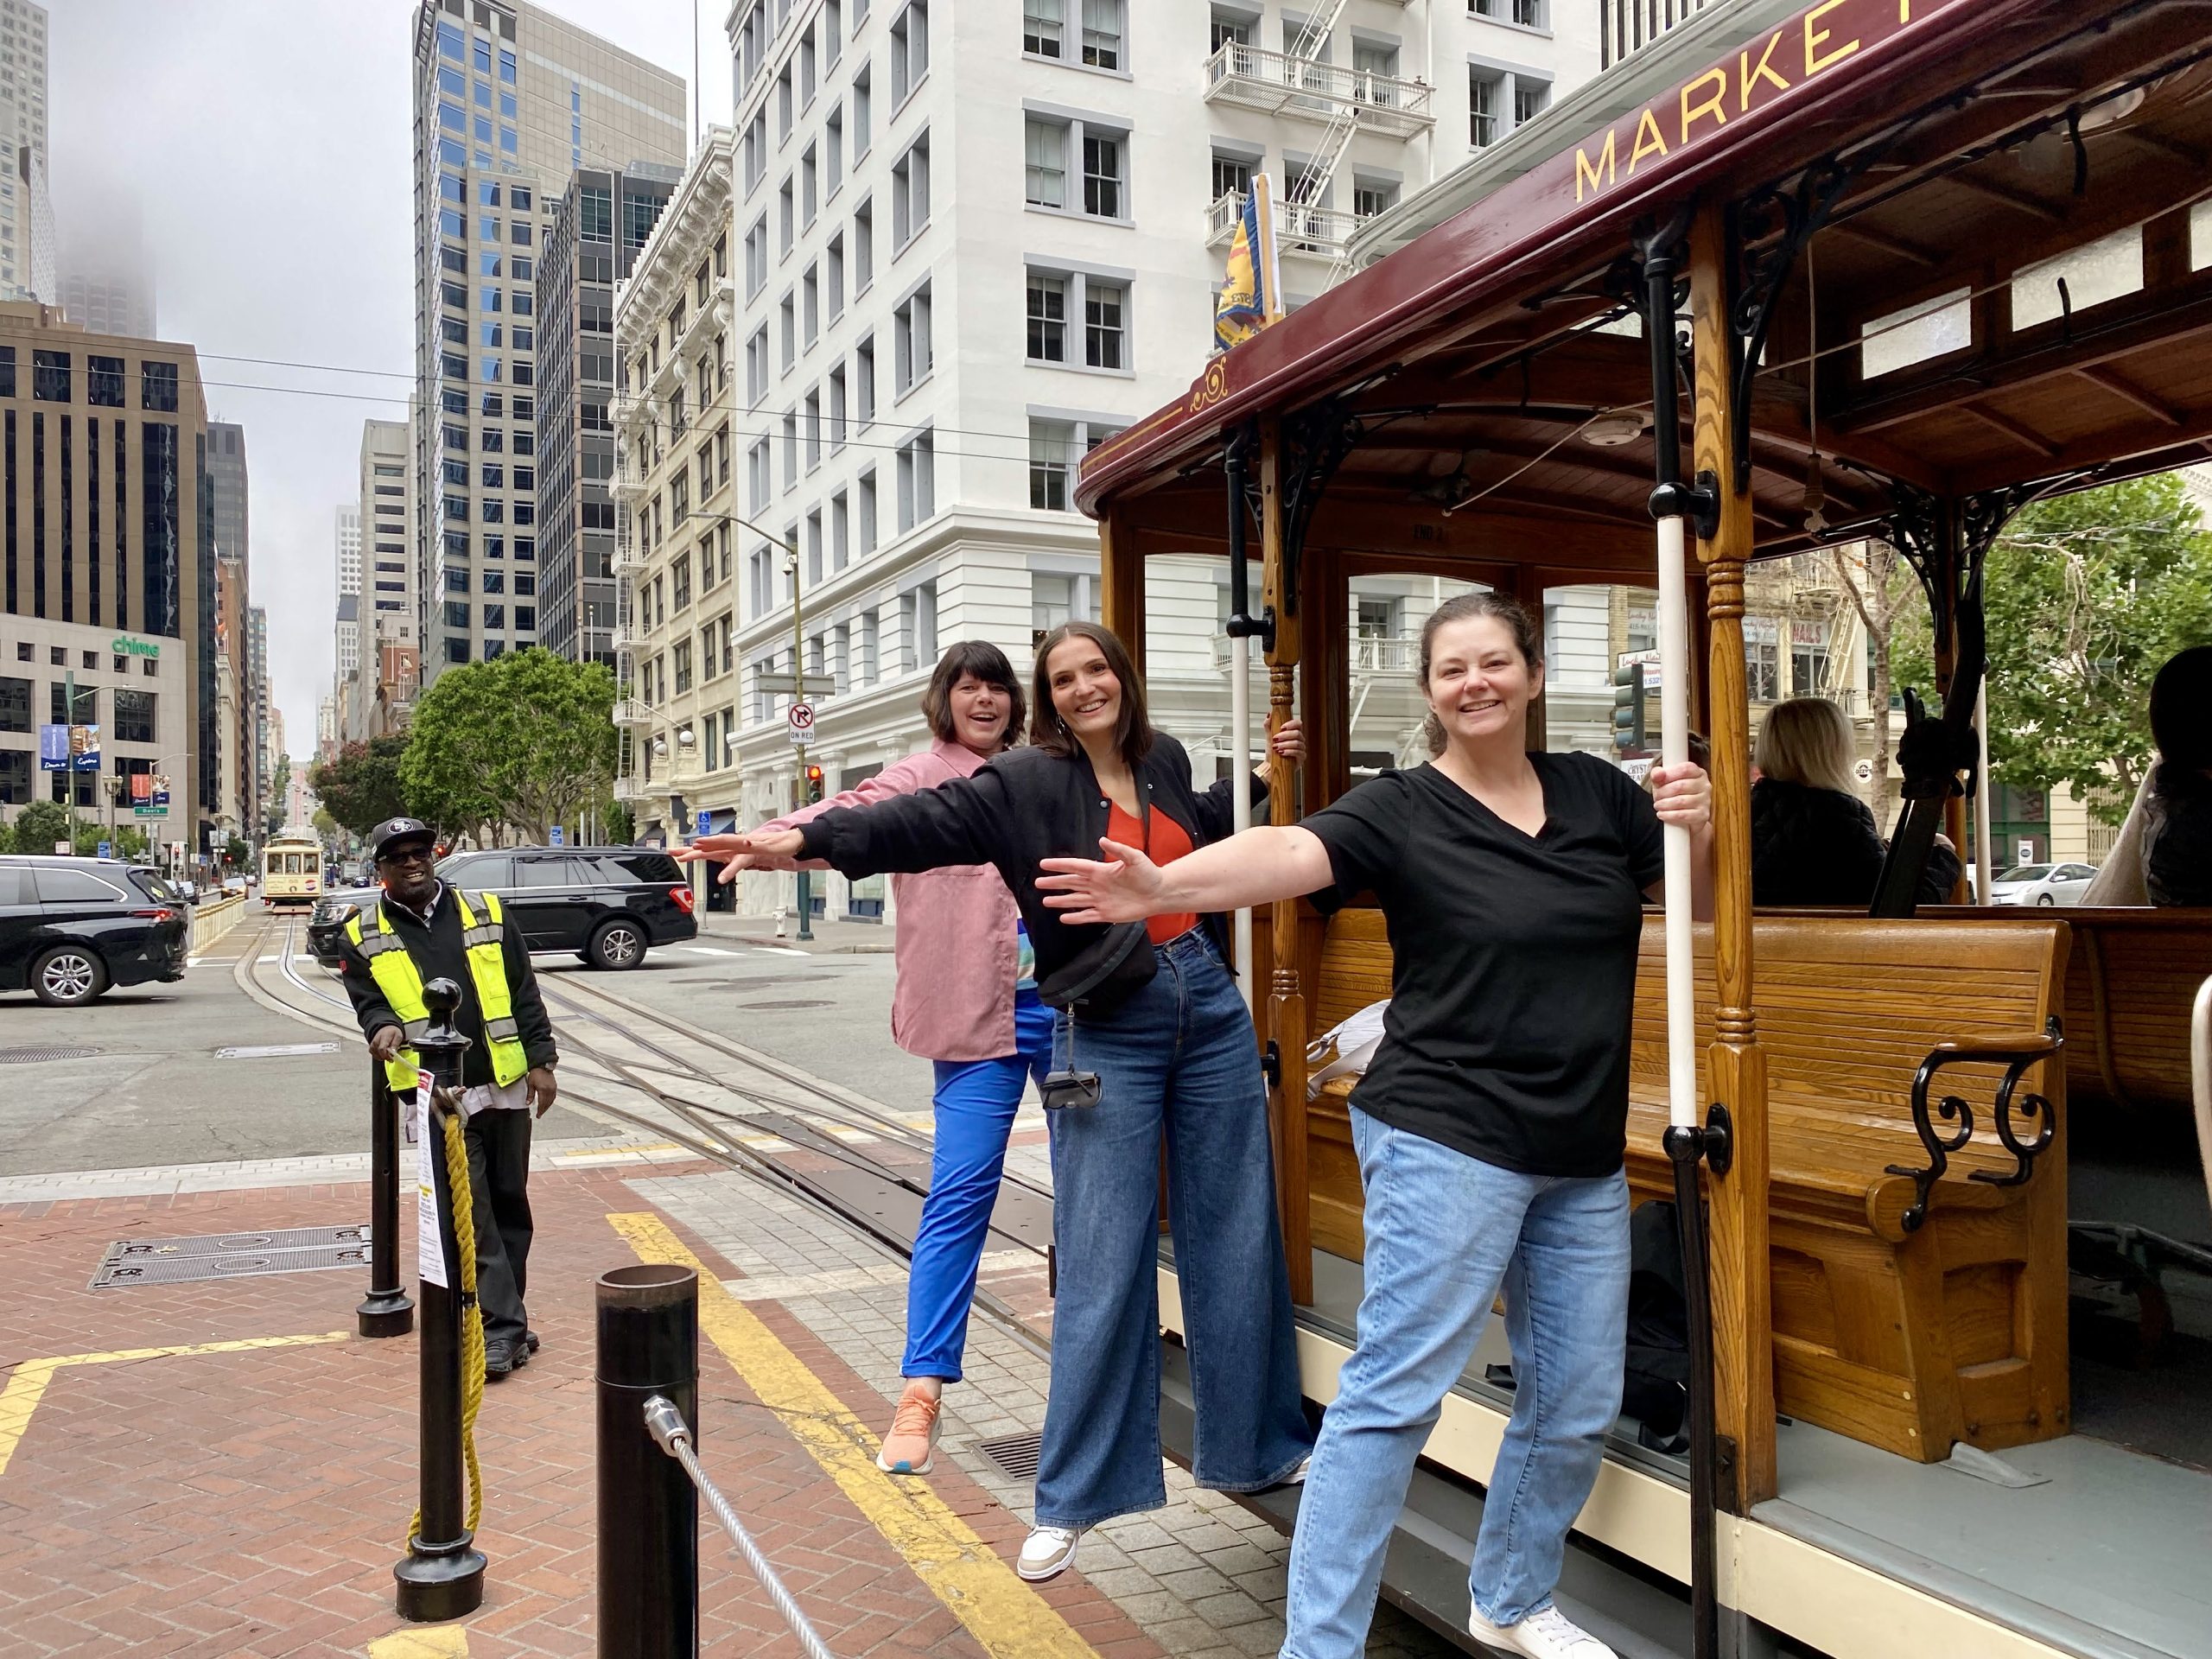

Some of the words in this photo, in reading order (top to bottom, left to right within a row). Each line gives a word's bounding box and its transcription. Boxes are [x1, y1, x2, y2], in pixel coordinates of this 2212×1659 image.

[1414, 524, 1433, 539] END
[1793, 622, 1821, 644] NAILS
[112, 635, 160, 658] chime
[1628, 764, 1650, 775] CRYST
